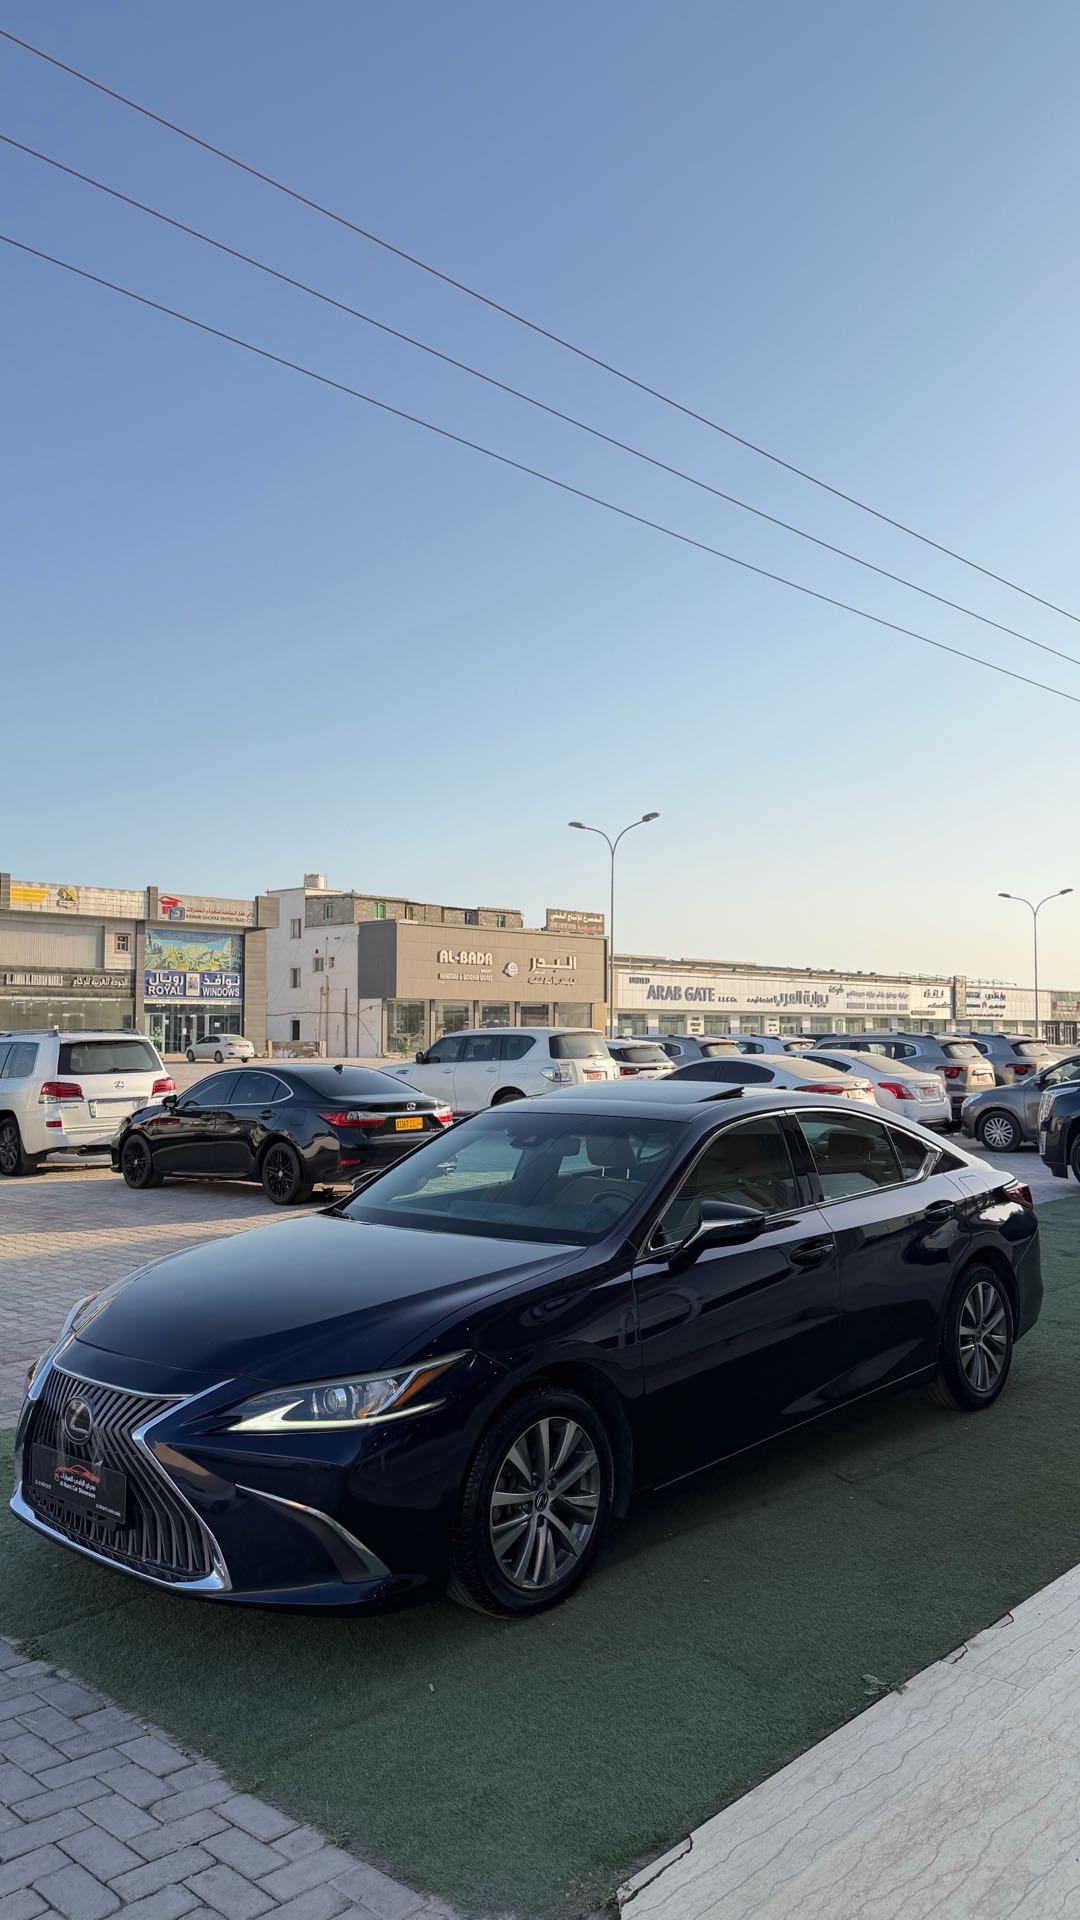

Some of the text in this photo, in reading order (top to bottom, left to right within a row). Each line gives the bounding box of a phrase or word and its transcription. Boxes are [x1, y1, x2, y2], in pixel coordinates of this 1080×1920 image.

[439, 949, 493, 966] AL-BADR
[532, 956, 577, 973] البدر
[149, 973, 240, 988] نوافذ رويال
[148, 986, 240, 998] ROYAL WINDOWS
[647, 985, 682, 1001] ARAB
[685, 987, 715, 1002] GATE
[803, 991, 829, 1008] بوابة
